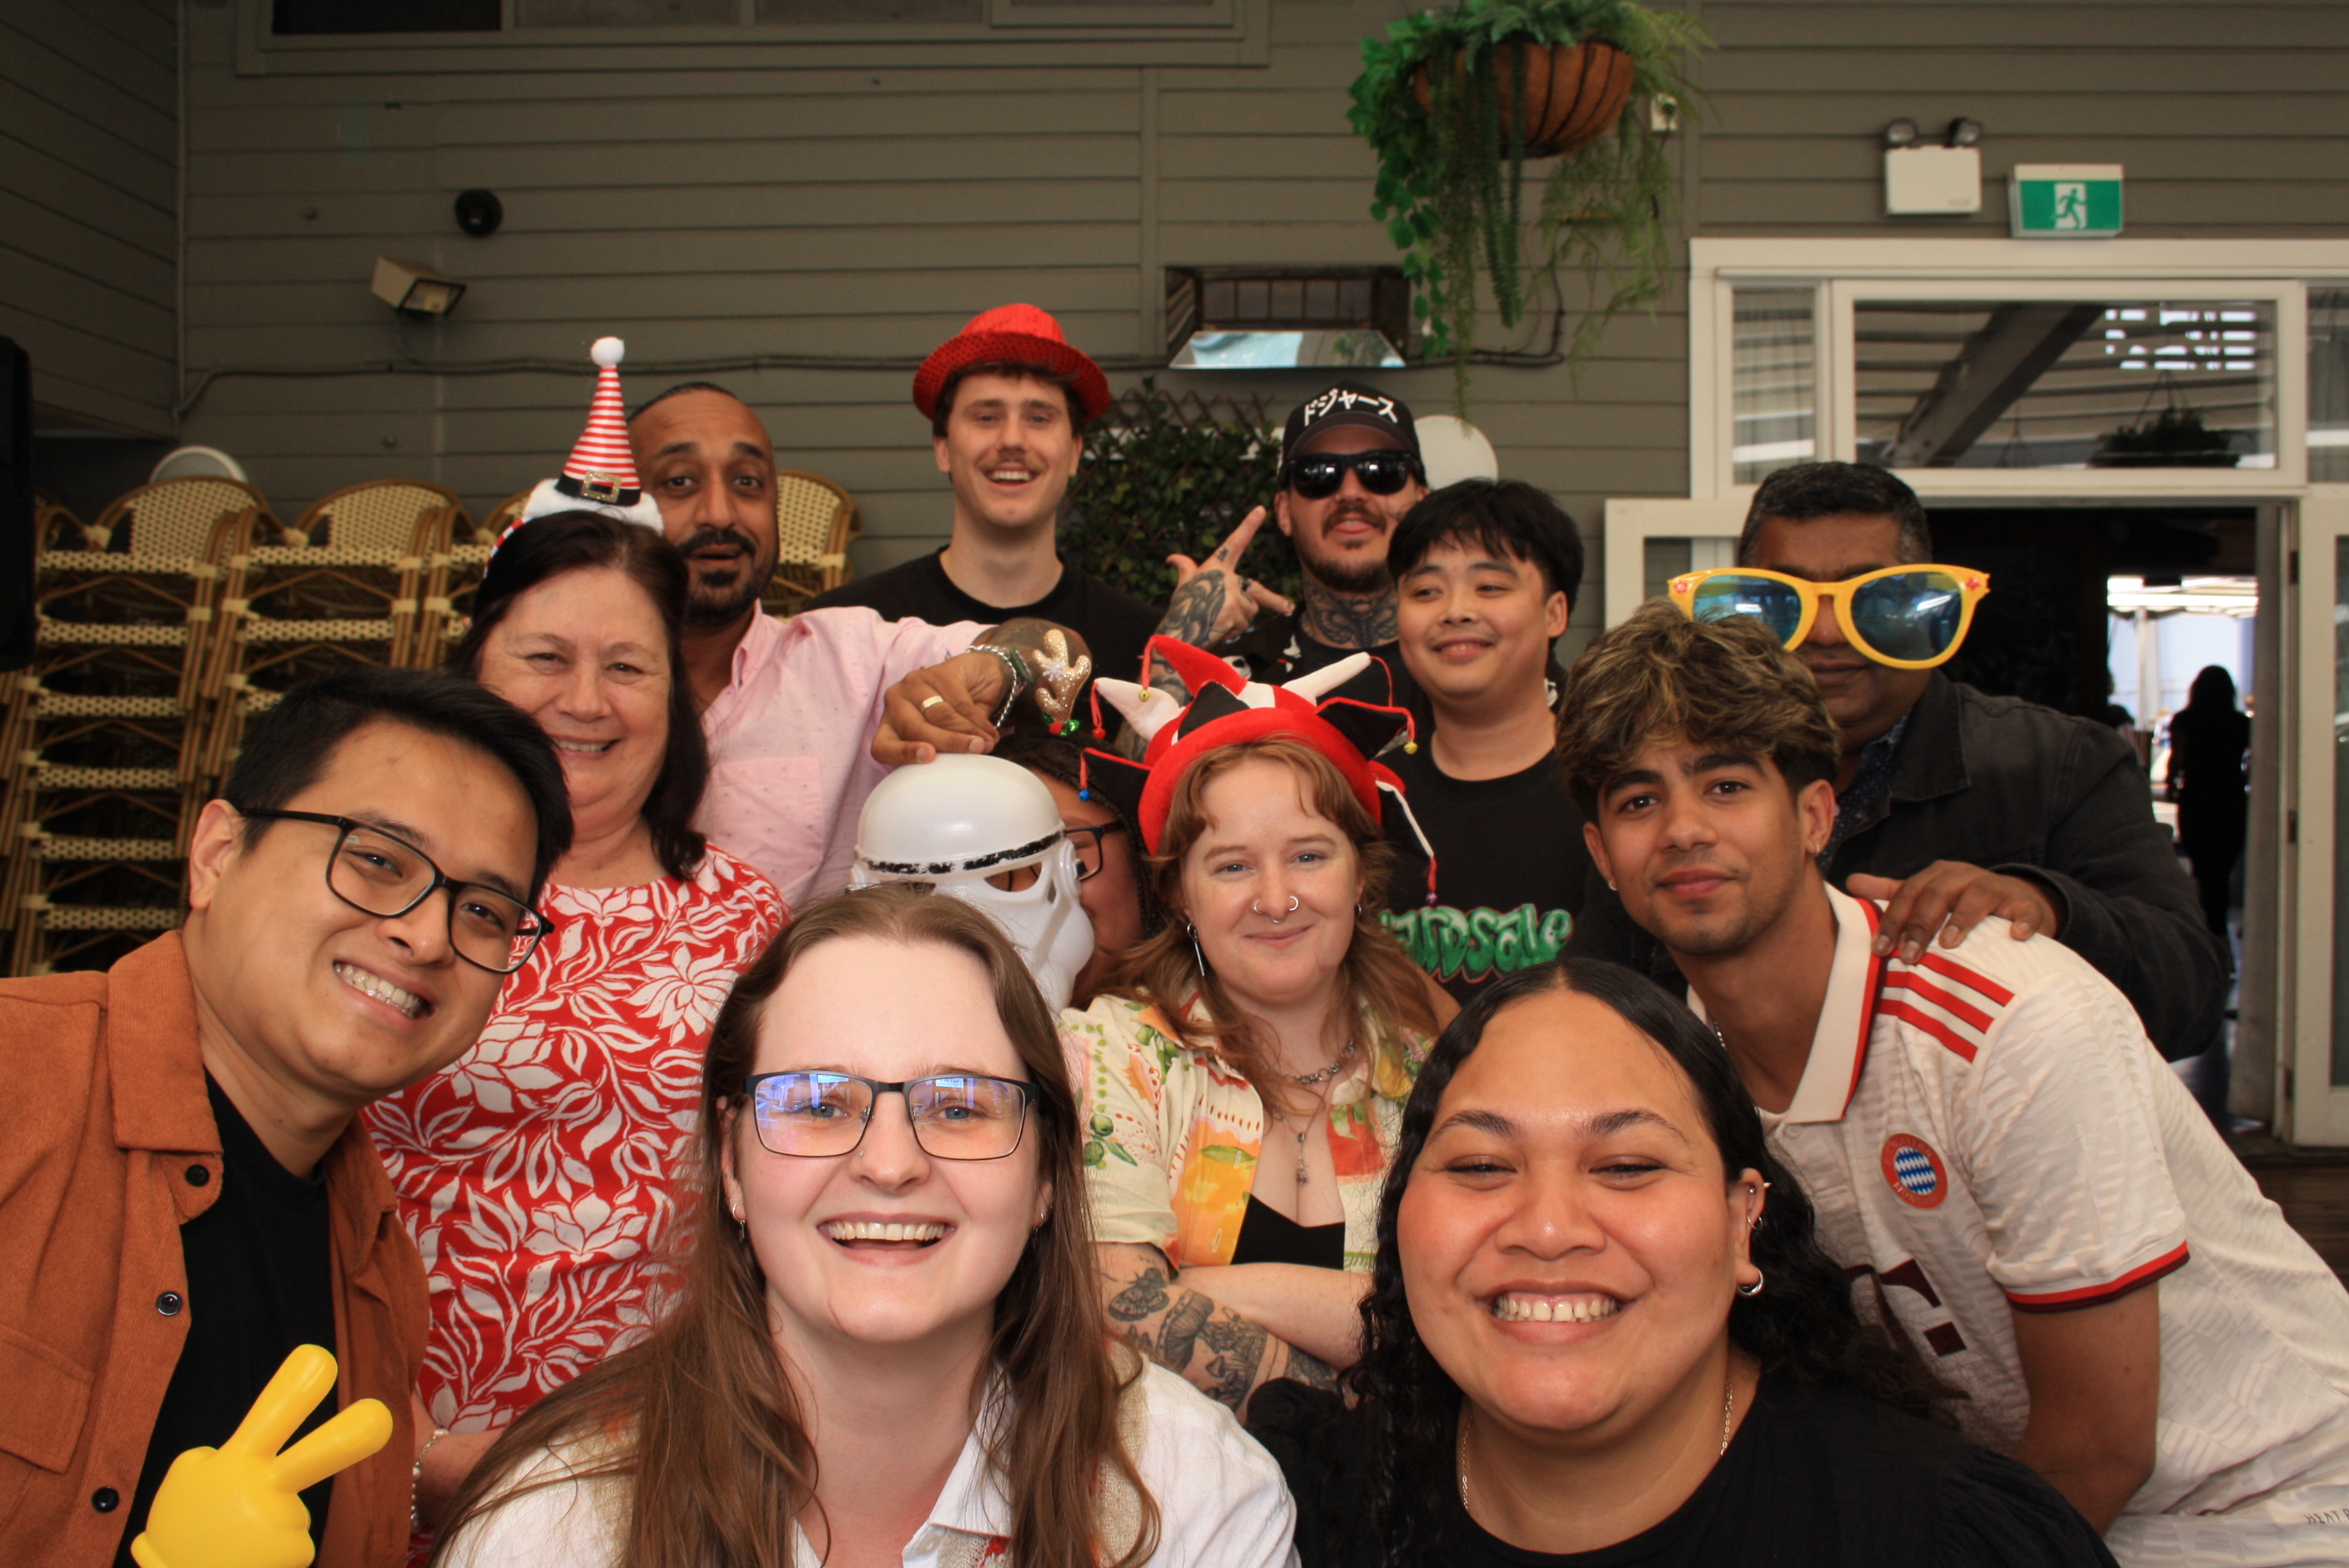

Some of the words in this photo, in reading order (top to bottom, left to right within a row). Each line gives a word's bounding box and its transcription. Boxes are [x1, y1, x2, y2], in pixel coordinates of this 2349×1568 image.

[1304, 388, 1398, 427] ドジャース
